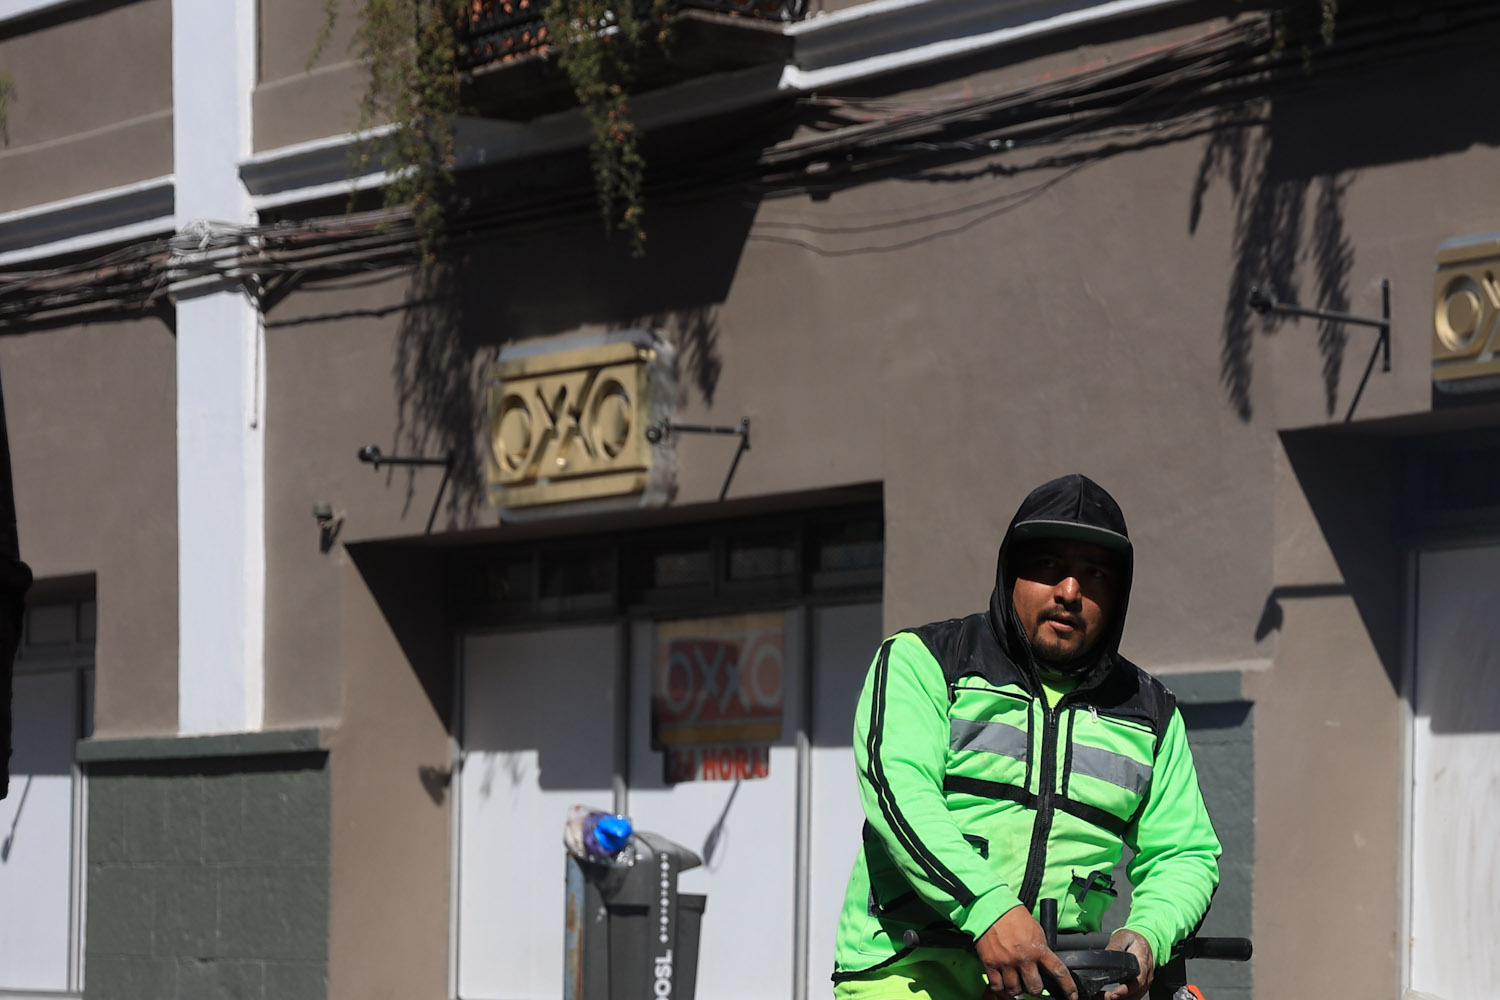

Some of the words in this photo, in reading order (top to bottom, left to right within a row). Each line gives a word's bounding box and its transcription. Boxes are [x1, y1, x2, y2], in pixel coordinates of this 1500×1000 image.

[492, 367, 633, 481] OXXO
[663, 633, 783, 722] OXXO
[702, 747, 769, 781] HORA
